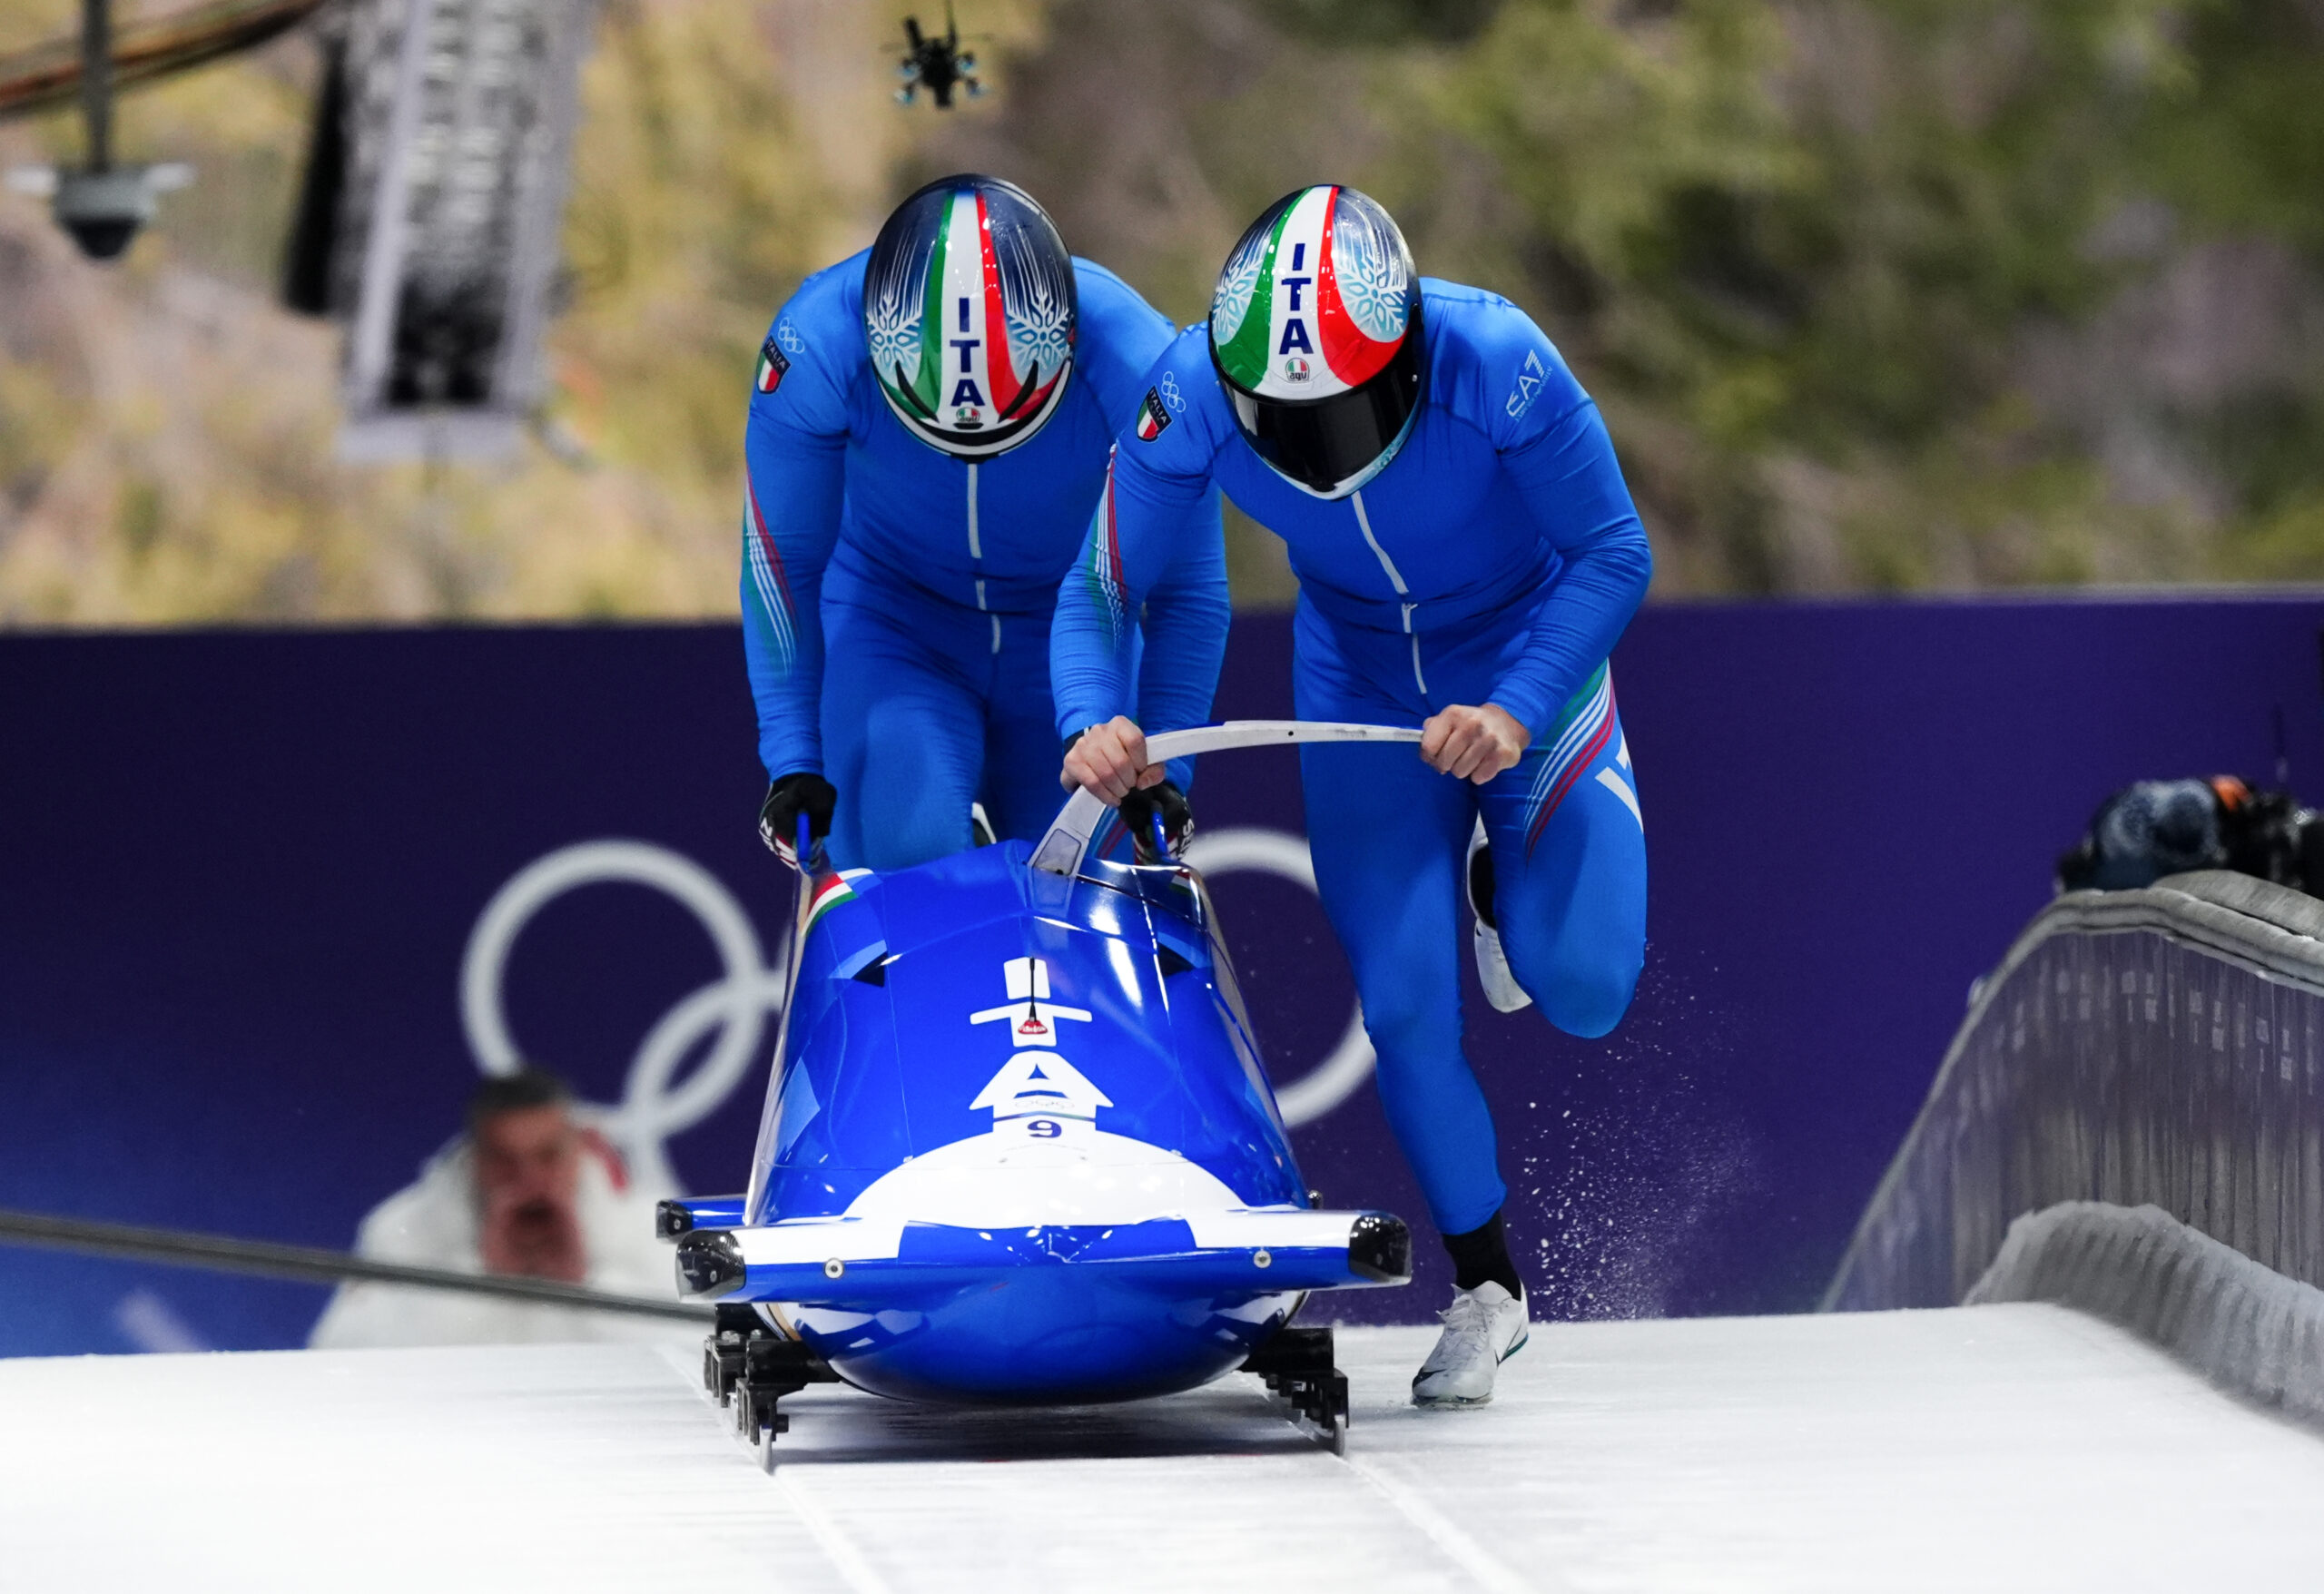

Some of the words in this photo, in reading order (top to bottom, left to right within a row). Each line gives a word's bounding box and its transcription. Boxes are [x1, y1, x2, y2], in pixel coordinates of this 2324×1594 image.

[1279, 242, 1314, 355] ITA
[950, 297, 985, 407] ITA
[1289, 372, 1307, 381] agv
[1506, 349, 1544, 417] EA7
[1148, 389, 1167, 423] ITALIA
[969, 957, 1114, 1111] ITA
[1027, 1119, 1062, 1138] 9
